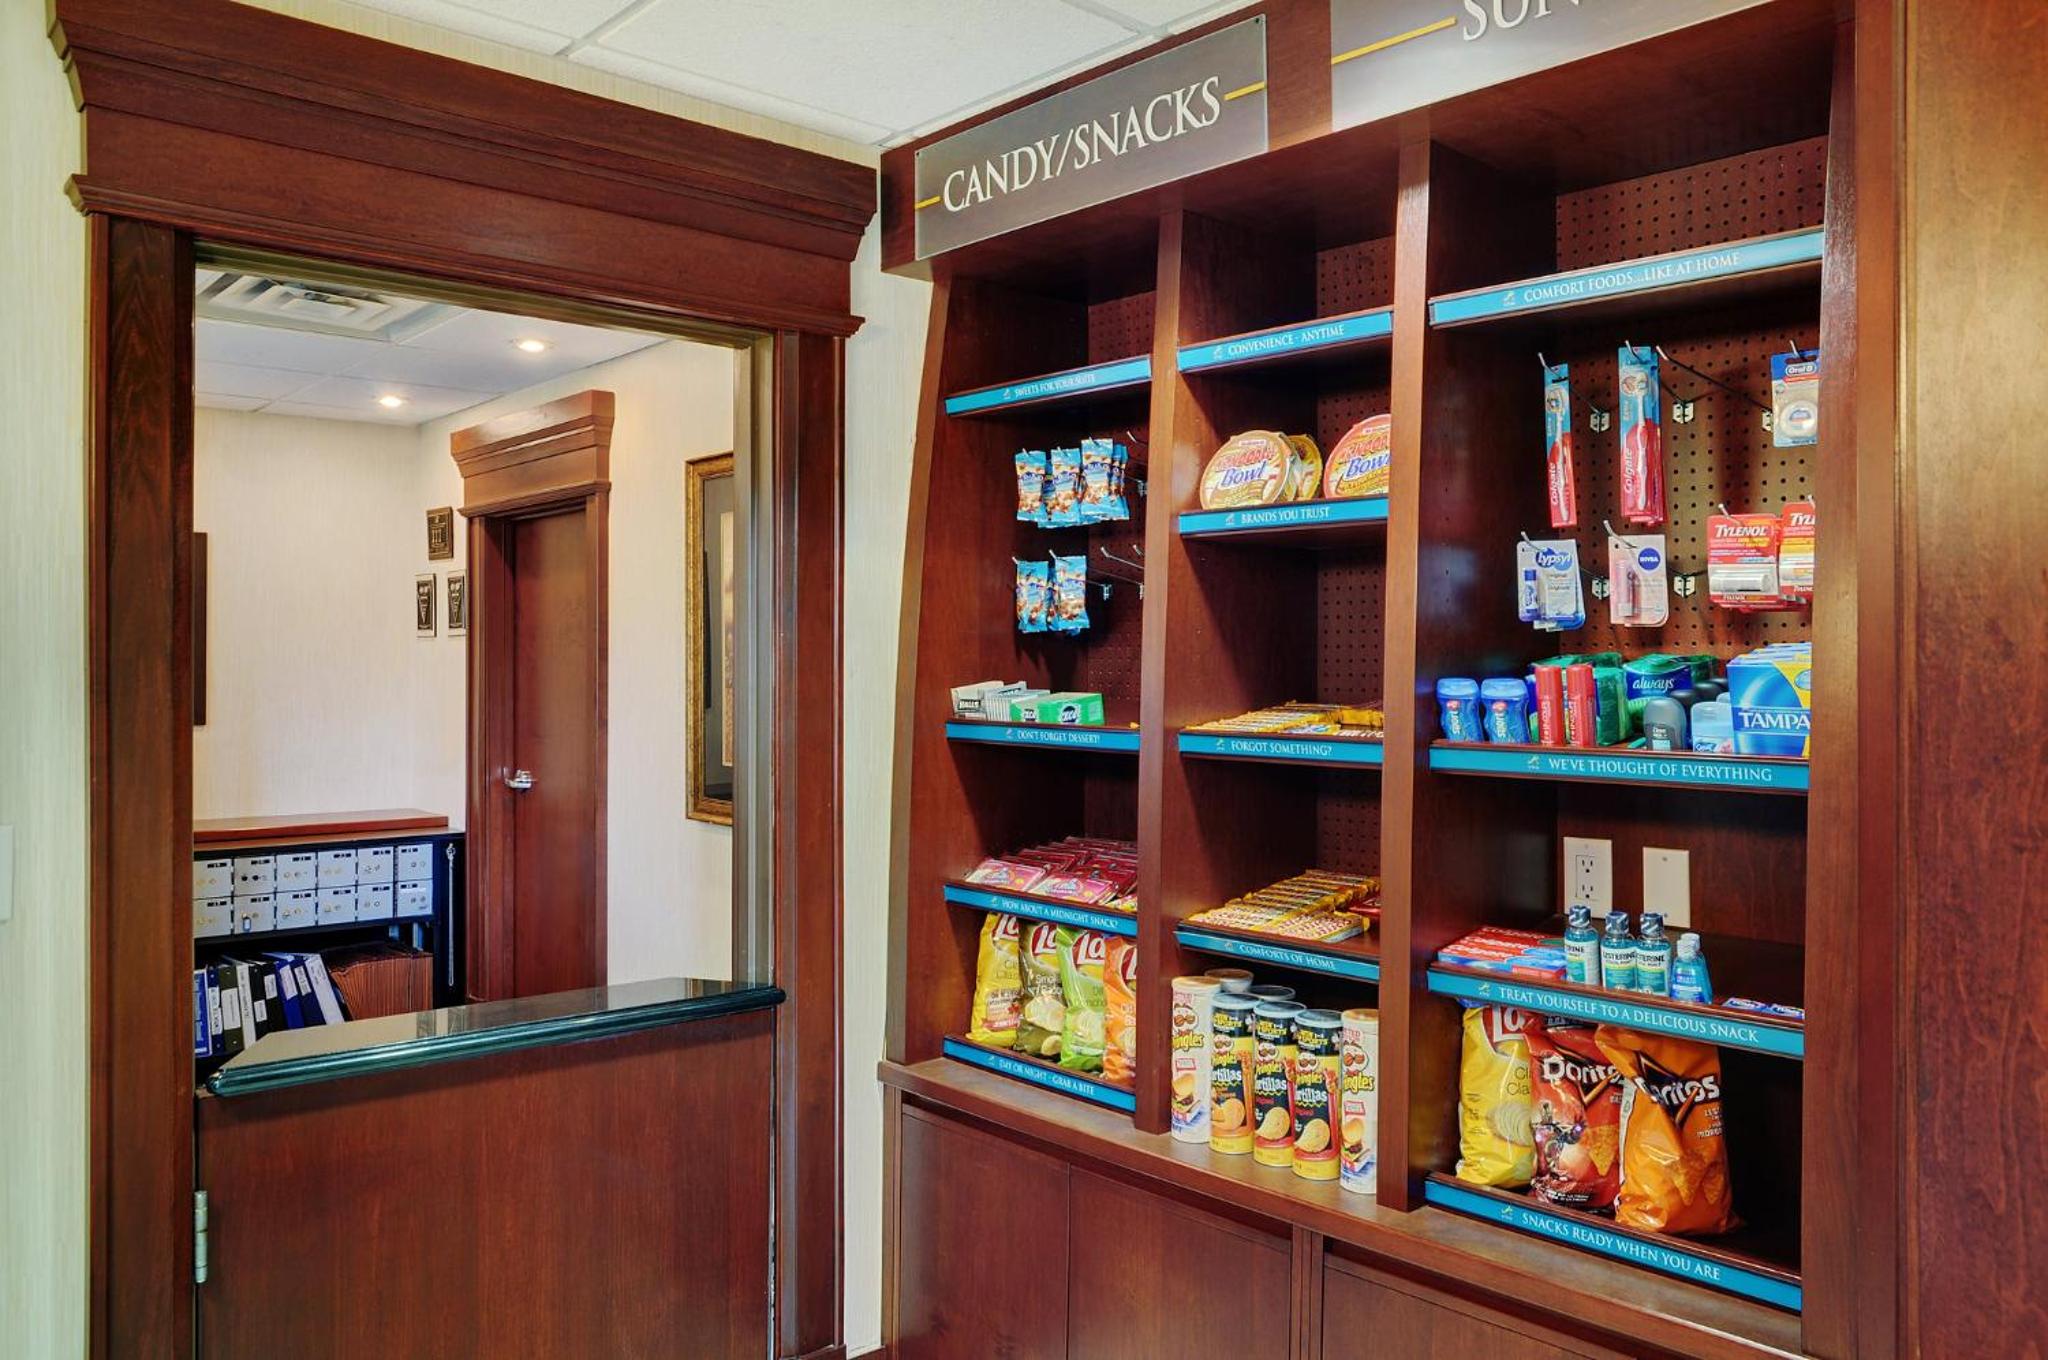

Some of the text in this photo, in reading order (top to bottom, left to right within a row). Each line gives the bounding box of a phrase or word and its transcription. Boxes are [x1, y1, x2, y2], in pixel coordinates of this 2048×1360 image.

[943, 76, 1222, 214] CANDY/SNACKS
[1523, 280, 1586, 303] COMFORT
[1677, 262, 1692, 276] AT
[1695, 253, 1741, 272] HOME
[1228, 334, 1294, 356] CONVENIENCE
[1301, 325, 1344, 343] ANYTIME
[1015, 384, 1039, 398] SWEETS
[1221, 459, 1267, 486] Bowl
[1549, 462, 1558, 505] Colgate
[1624, 447, 1635, 494] Colgate
[1241, 507, 1330, 524] BRANDS YOU TRUST
[1715, 524, 1769, 538] TYLENOL
[1632, 676, 1675, 696] always
[1017, 729, 1039, 740] DON'T
[1040, 730, 1067, 742] FORGET
[1231, 739, 1332, 757] FORGOT SOMETHING?
[1548, 758, 1773, 782] WE'VE THOUGHT OF EVERYTHING
[1002, 899, 1019, 912] HOW
[1050, 907, 1088, 924] MIDNIGHT
[1239, 944, 1335, 971] COMFORTS OF HOME
[1499, 987, 1759, 1043] TREAT YOURSELF TO A DELICIOUS SNACK
[1521, 1213, 1720, 1281] SNACKS READY WHEN YOU ARE
